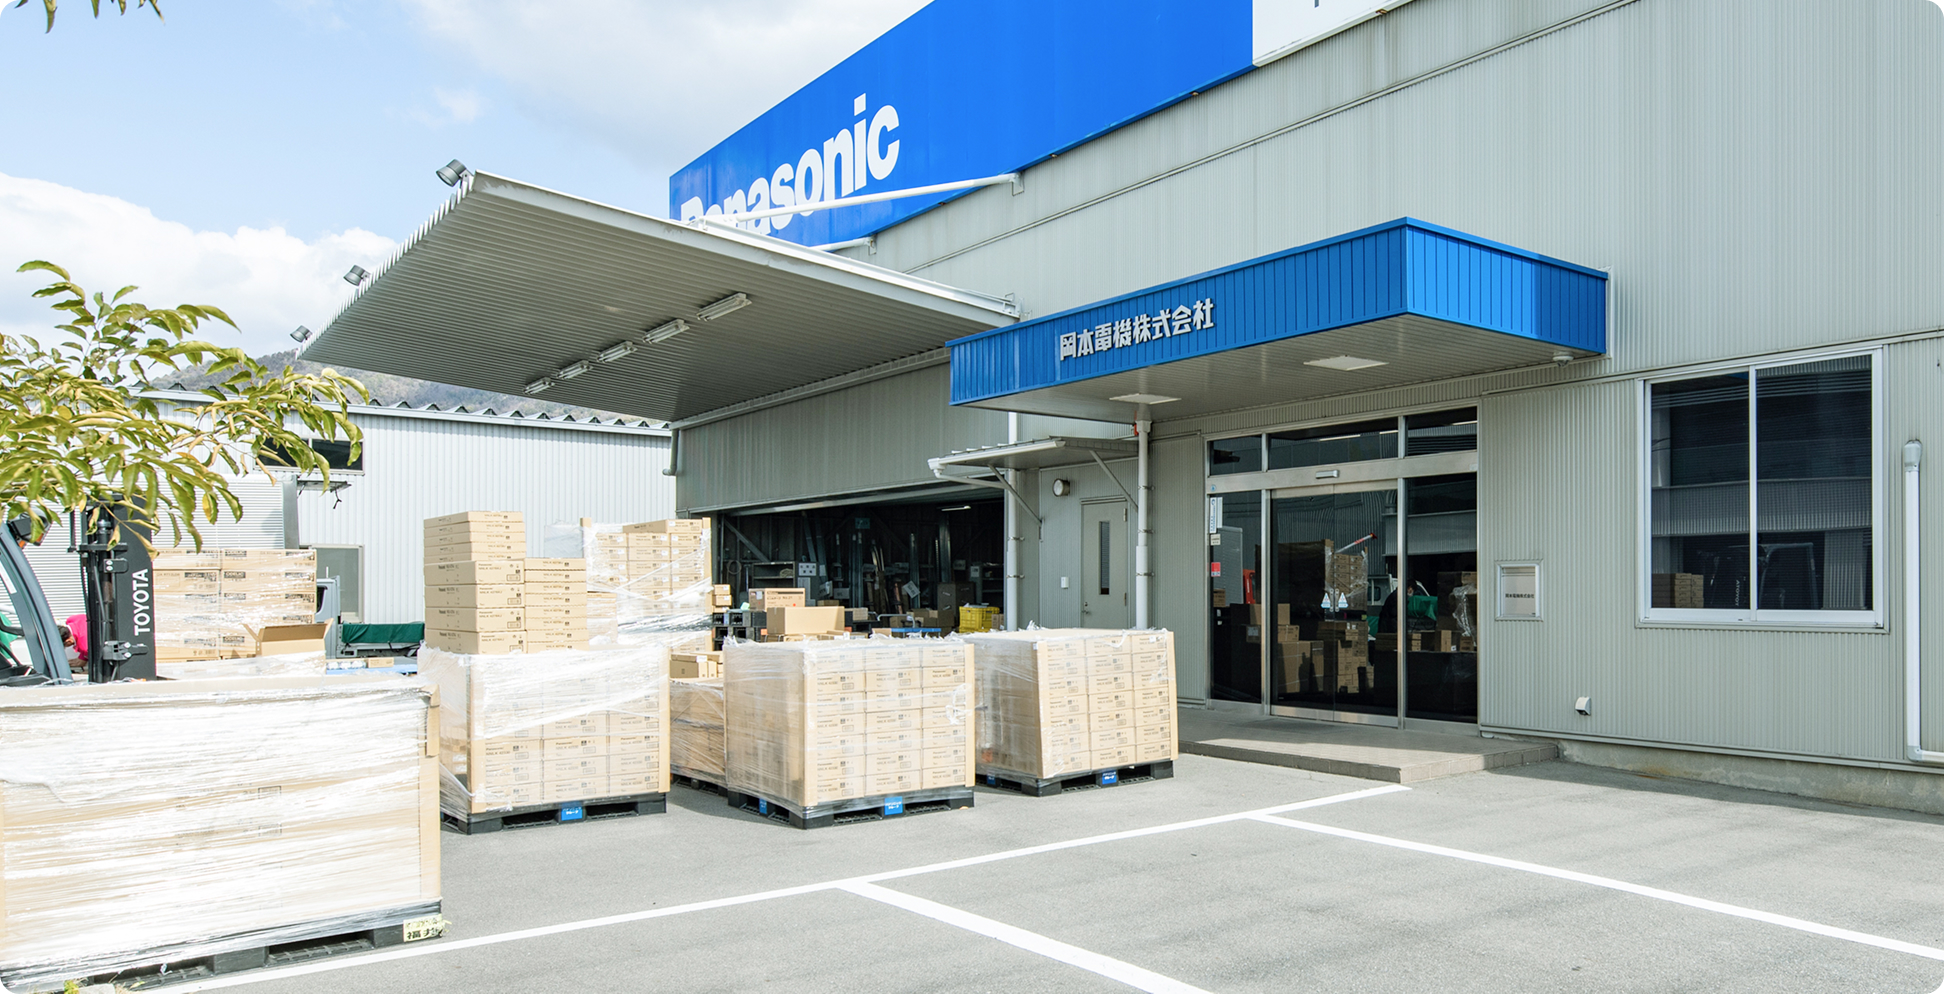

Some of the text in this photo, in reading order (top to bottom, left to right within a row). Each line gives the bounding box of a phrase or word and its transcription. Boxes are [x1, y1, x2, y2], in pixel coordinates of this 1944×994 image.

[681, 93, 900, 236] nasonic
[1060, 298, 1214, 361] 岡本電機株式会社
[132, 568, 151, 637] TOYOTA
